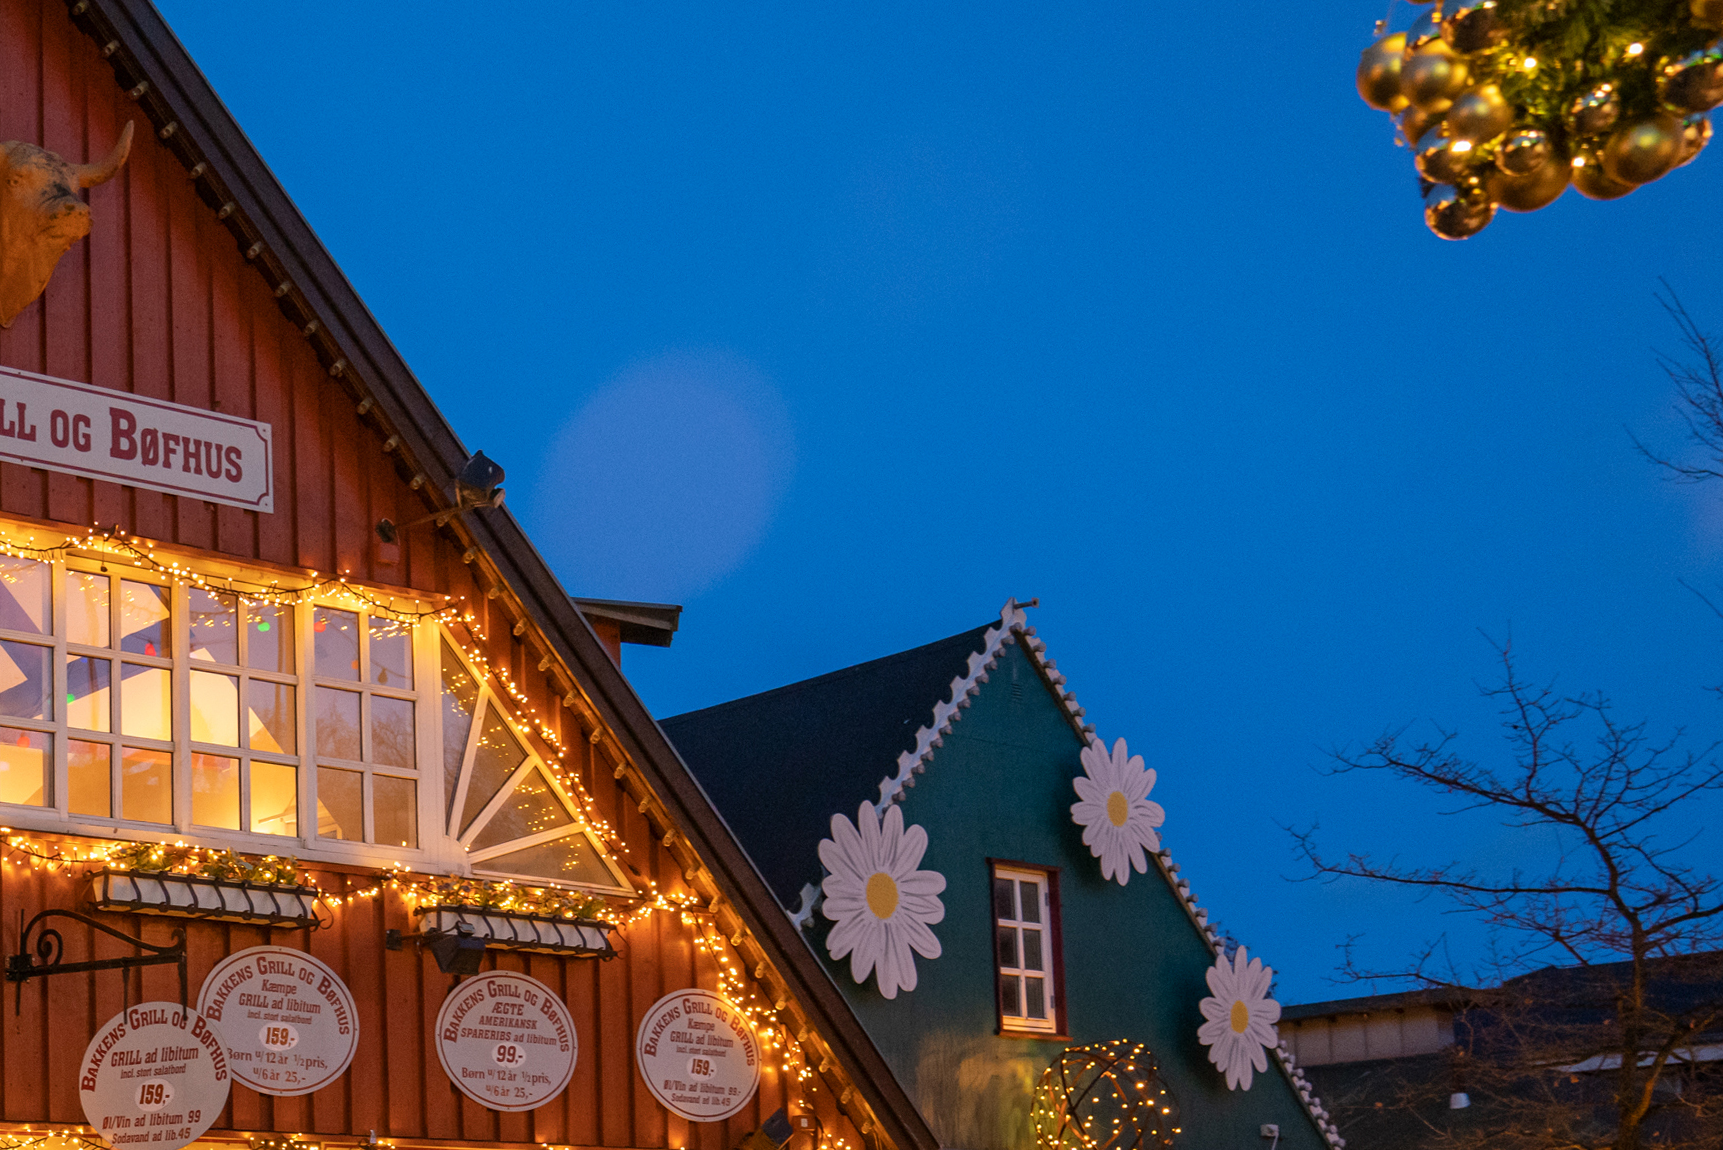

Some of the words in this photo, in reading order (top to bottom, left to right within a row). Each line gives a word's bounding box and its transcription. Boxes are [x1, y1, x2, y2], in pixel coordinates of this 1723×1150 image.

[50, 408, 91, 453] OG
[109, 406, 243, 484] BØFHUS
[206, 965, 253, 1022] BAKKENS
[256, 956, 295, 977] GRILL
[298, 967, 315, 985] OG
[317, 975, 350, 1035] BØFHUS
[261, 980, 297, 996] Kæmpe
[238, 992, 268, 1008] GRILL
[271, 998, 284, 1010] ad
[287, 999, 321, 1014] libitum
[492, 1002, 524, 1016] ÆGTE
[682, 998, 713, 1015] GRILL
[443, 989, 485, 1043] BAKKENS
[487, 980, 521, 998] GRILL
[524, 990, 538, 1006] OG
[540, 997, 569, 1052] BØFHUS
[478, 1016, 537, 1029] AMERIKANSK
[461, 1028, 511, 1041] SPARERIBS
[514, 1033, 524, 1042] ad
[526, 1033, 557, 1045] libitum
[81, 1023, 126, 1092] BAKKENS
[129, 1008, 168, 1030] GRILL
[191, 1015, 228, 1081] BØFHUS
[111, 1050, 142, 1068] GRILL
[144, 1051, 157, 1064] ad
[161, 1047, 199, 1064] libitum
[134, 1115, 146, 1128] ad
[149, 1112, 183, 1127] libitum
[112, 1130, 149, 1144] Sodavand
[152, 1132, 163, 1142] ad
